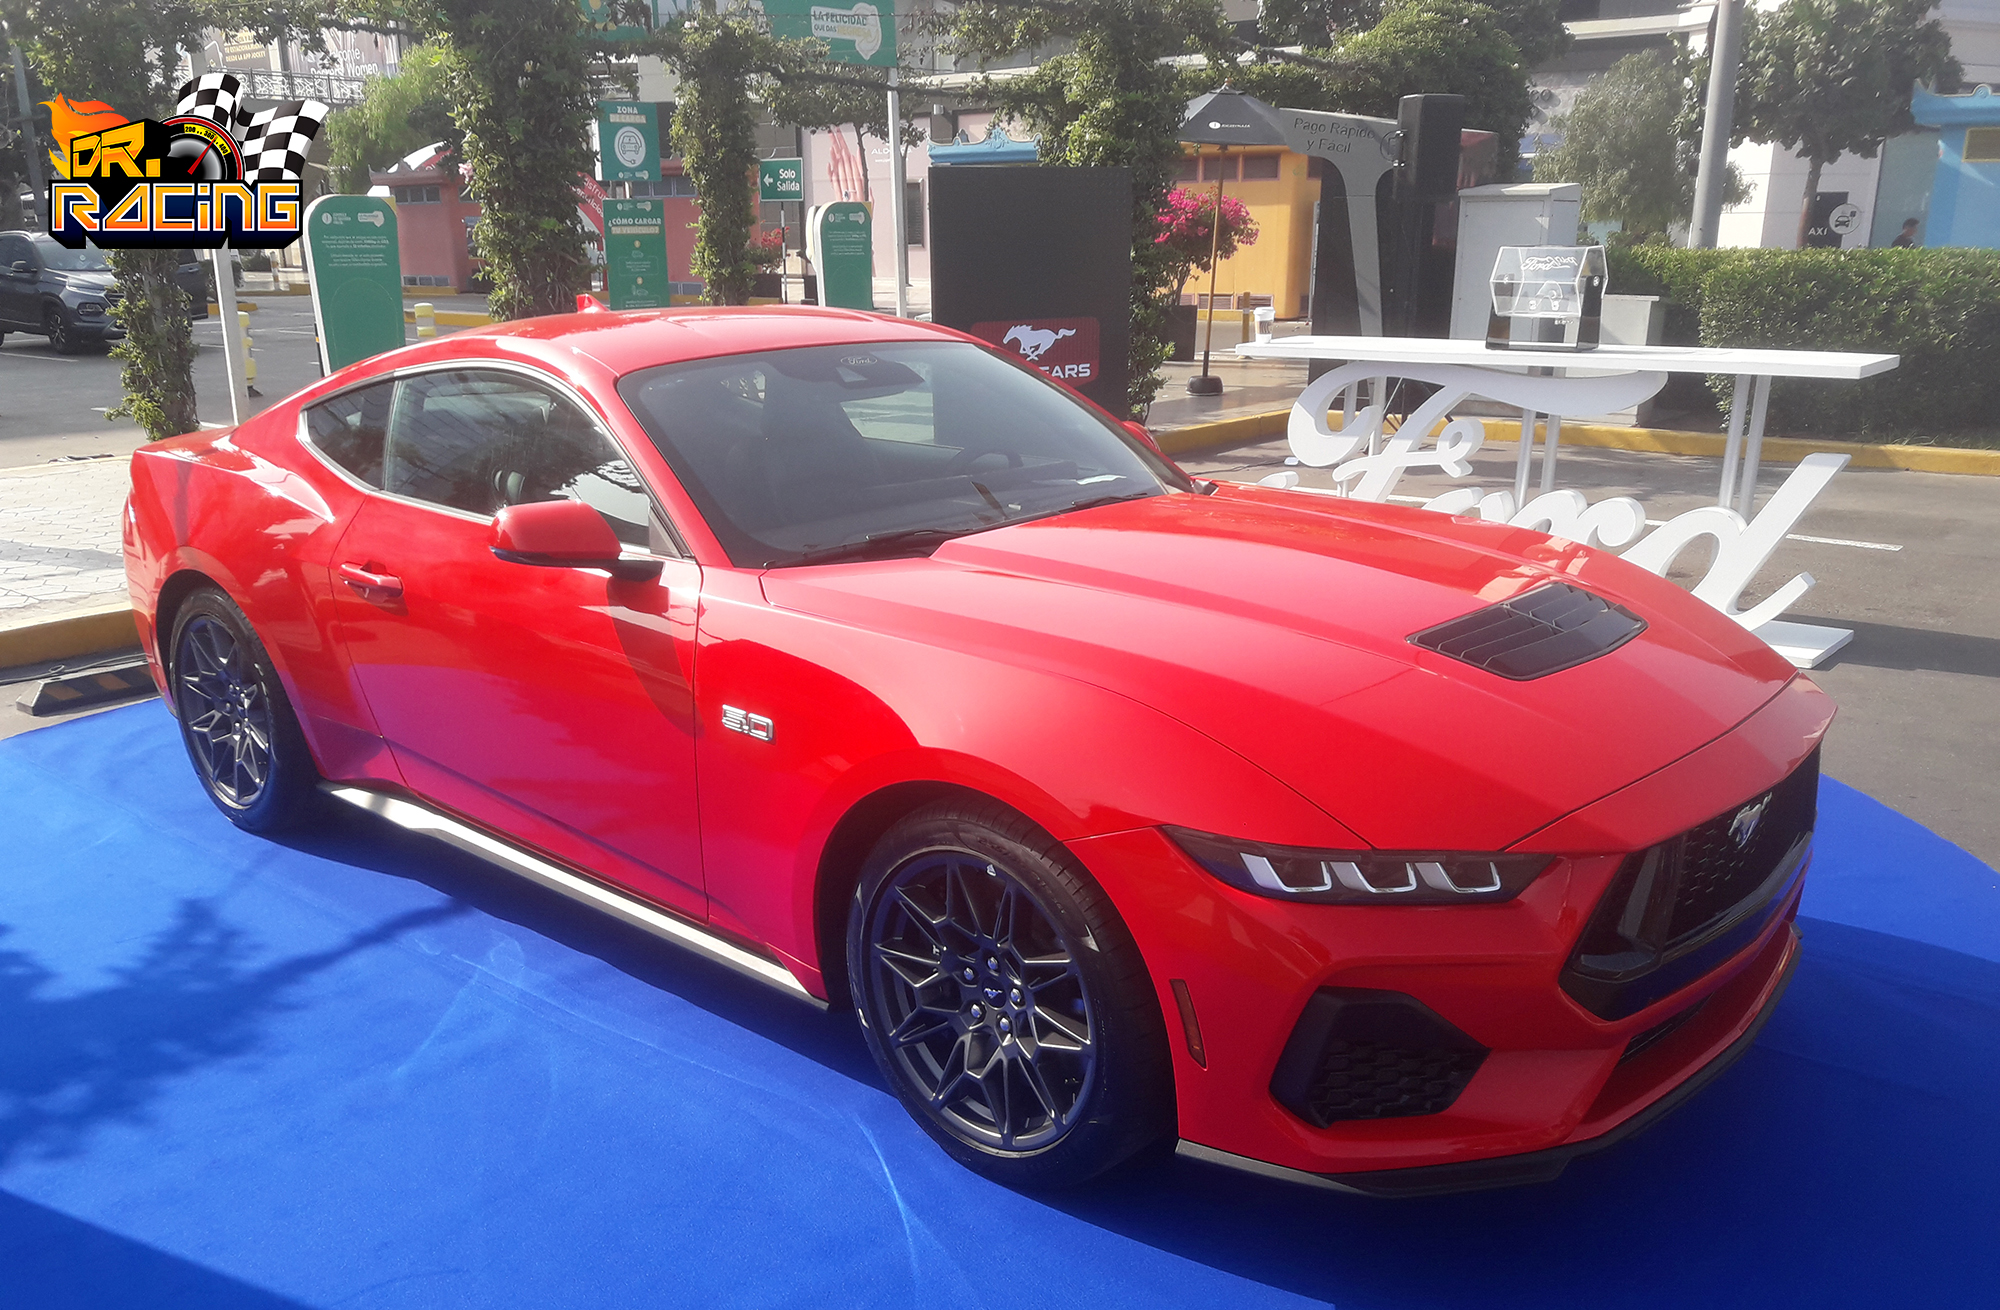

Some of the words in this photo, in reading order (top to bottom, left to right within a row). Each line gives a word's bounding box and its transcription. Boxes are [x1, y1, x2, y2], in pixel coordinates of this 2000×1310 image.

[617, 106, 638, 114] ZONA
[1294, 118, 1326, 134] Pago
[1330, 122, 1375, 139] Rápido
[1307, 140, 1315, 151] y
[1318, 139, 1352, 153] Fácil
[779, 168, 796, 179] Solo
[777, 180, 800, 191] Salida
[634, 217, 662, 225] CARGAR
[1808, 227, 1828, 236] AXI
[722, 704, 773, 741] 5.0
